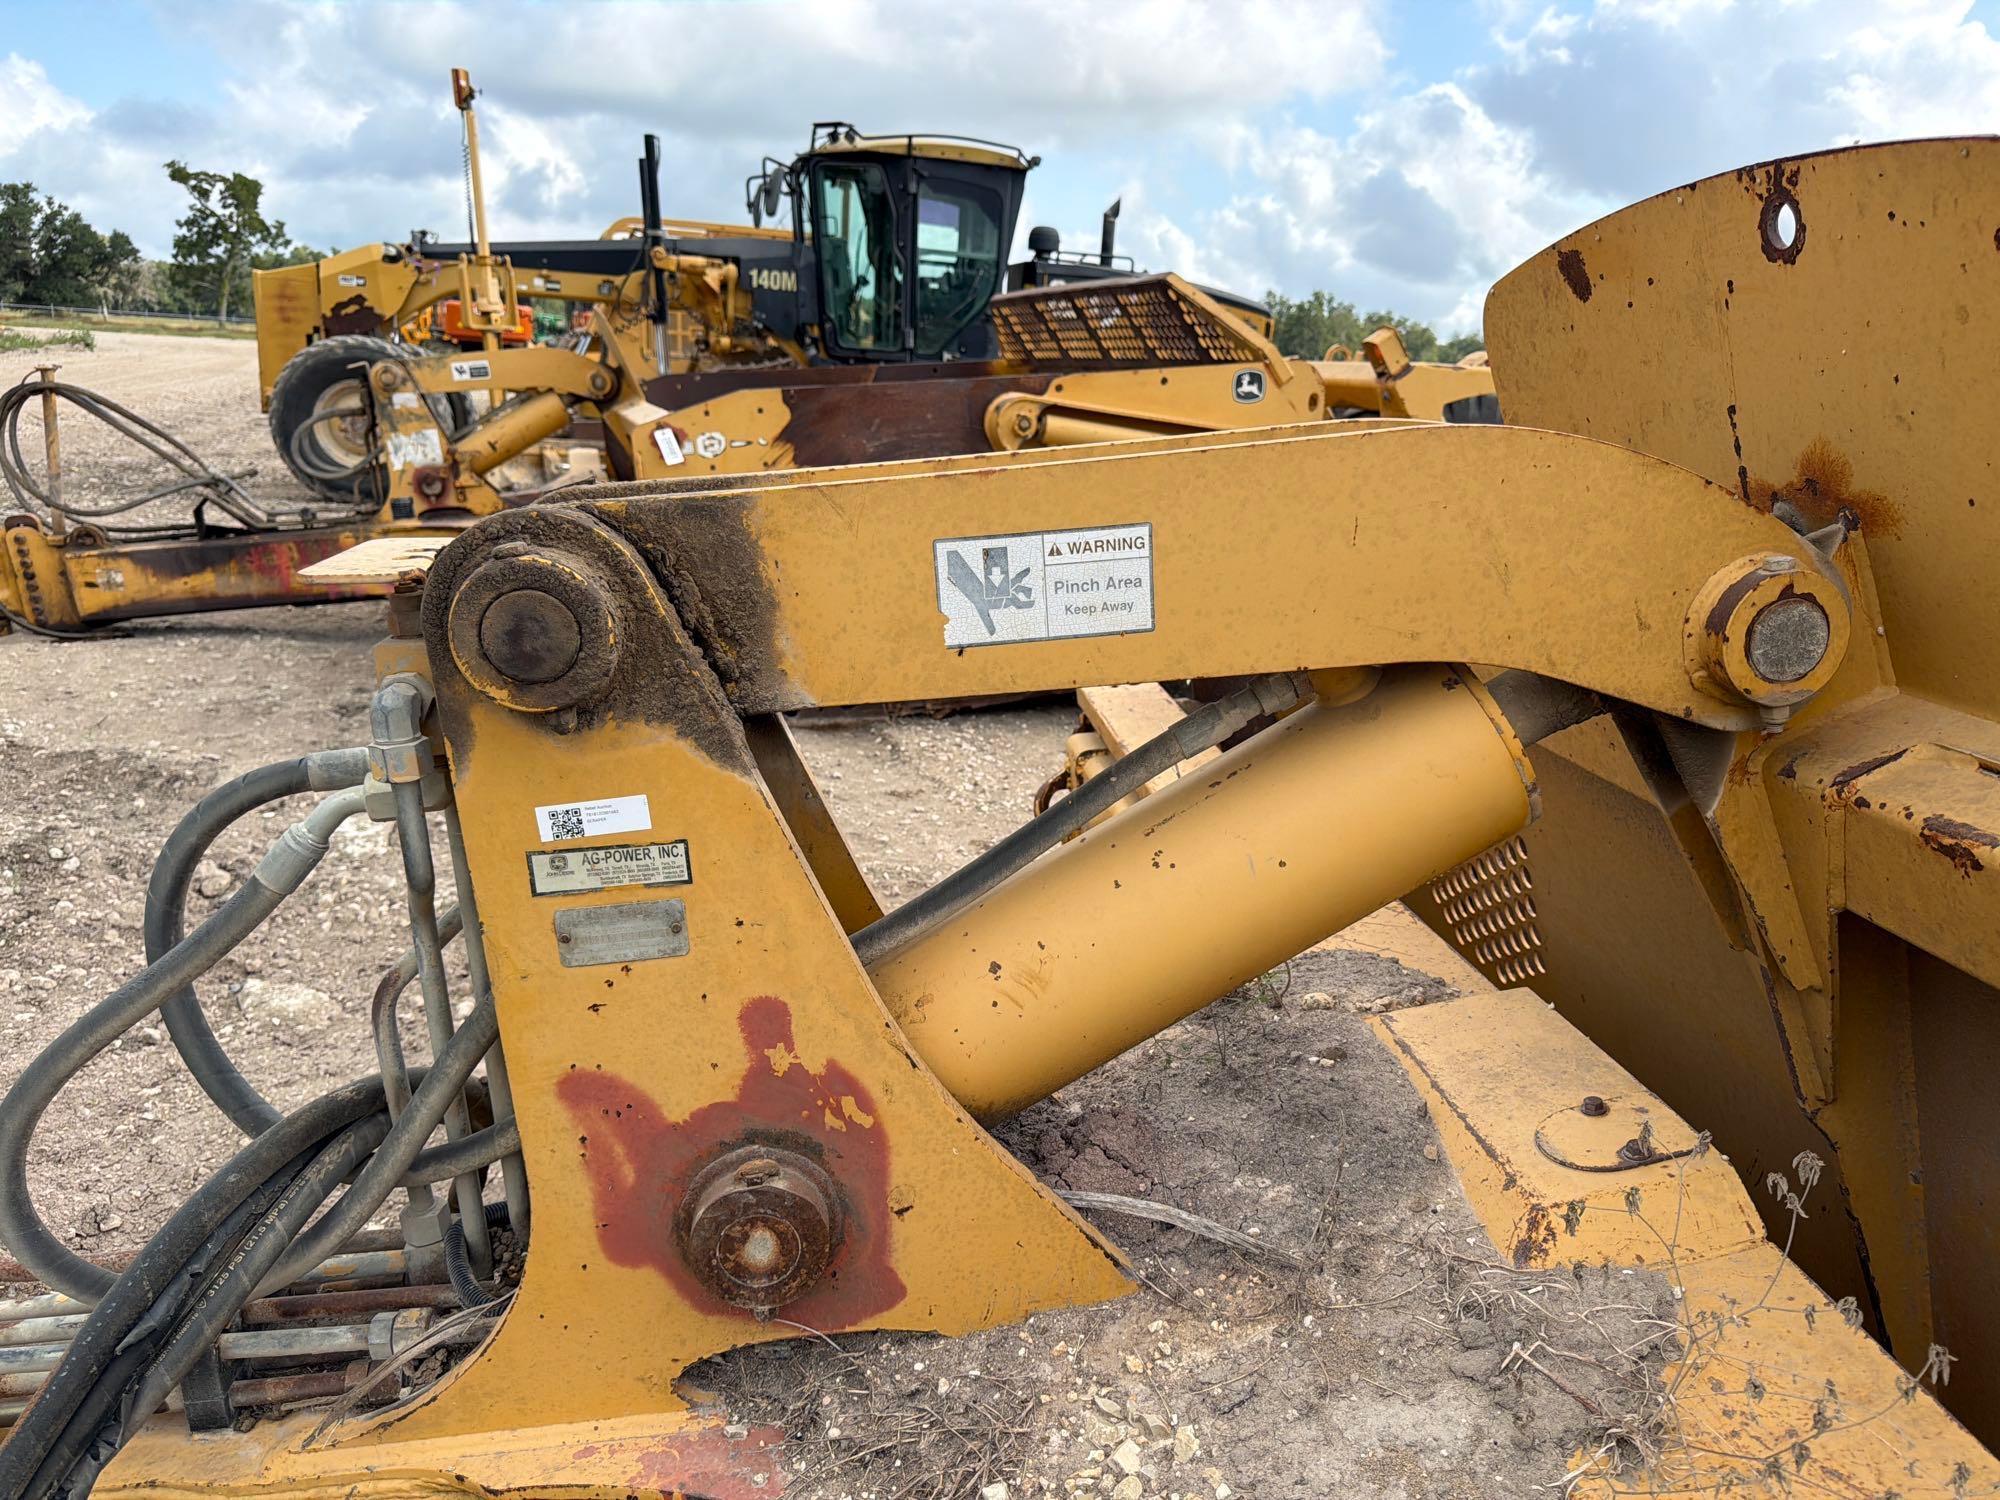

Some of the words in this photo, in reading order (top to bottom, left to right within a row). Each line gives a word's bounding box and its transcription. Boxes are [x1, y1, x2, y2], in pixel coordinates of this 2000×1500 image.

[748, 267, 798, 292] 140M
[1067, 536, 1145, 555] WARNING
[1054, 578, 1100, 594] Pinch
[1106, 576, 1142, 590] Area
[1065, 604, 1097, 615] Keep
[1101, 601, 1134, 612] Away
[581, 848, 656, 866] AG-POWER,
[658, 845, 683, 859] INC.
[207, 1271, 230, 1297] 3125
[228, 1252, 247, 1271] PSI
[265, 1199, 289, 1225] MPa)
